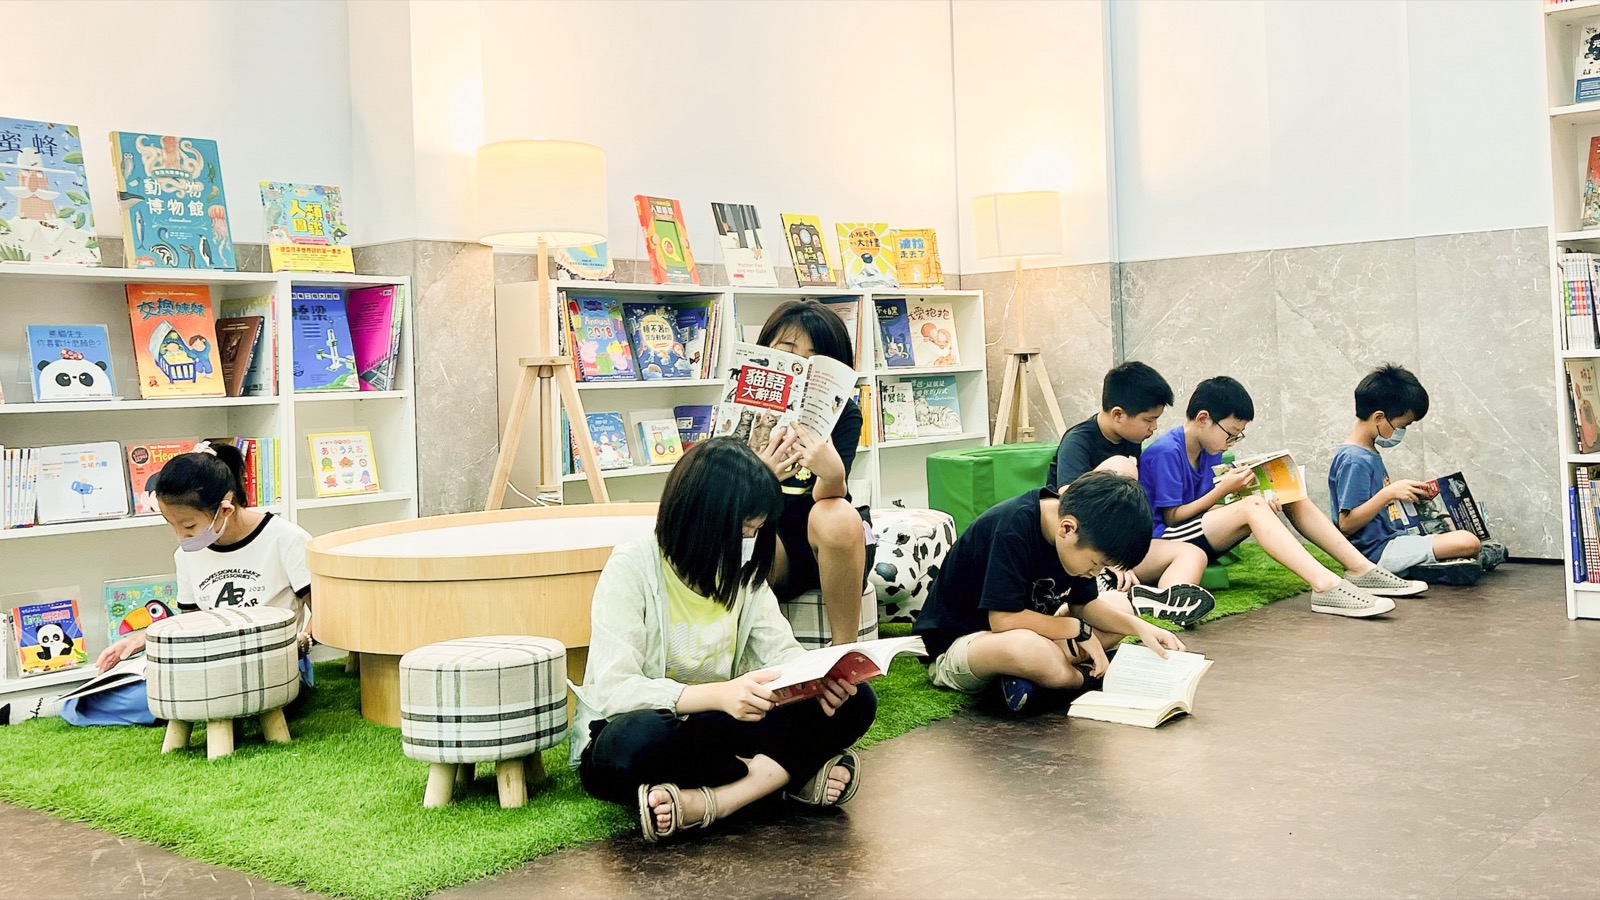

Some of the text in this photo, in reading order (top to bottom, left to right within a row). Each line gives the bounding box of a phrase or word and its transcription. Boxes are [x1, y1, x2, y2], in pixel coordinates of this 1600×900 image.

[0, 130, 58, 157] 蜜蜂
[143, 178, 202, 198] 動物
[146, 199, 205, 217] 博物館
[289, 199, 324, 221] 人類
[137, 297, 205, 320] 交換妹妹
[585, 316, 611, 326] Annual
[587, 326, 614, 340] 2018
[745, 368, 787, 391] 貓語
[741, 386, 783, 404] 大辭典
[321, 445, 364, 456] あいうえお
[199, 569, 241, 589] PROFESSIONAL
[113, 585, 174, 601] 動物大驚奇
